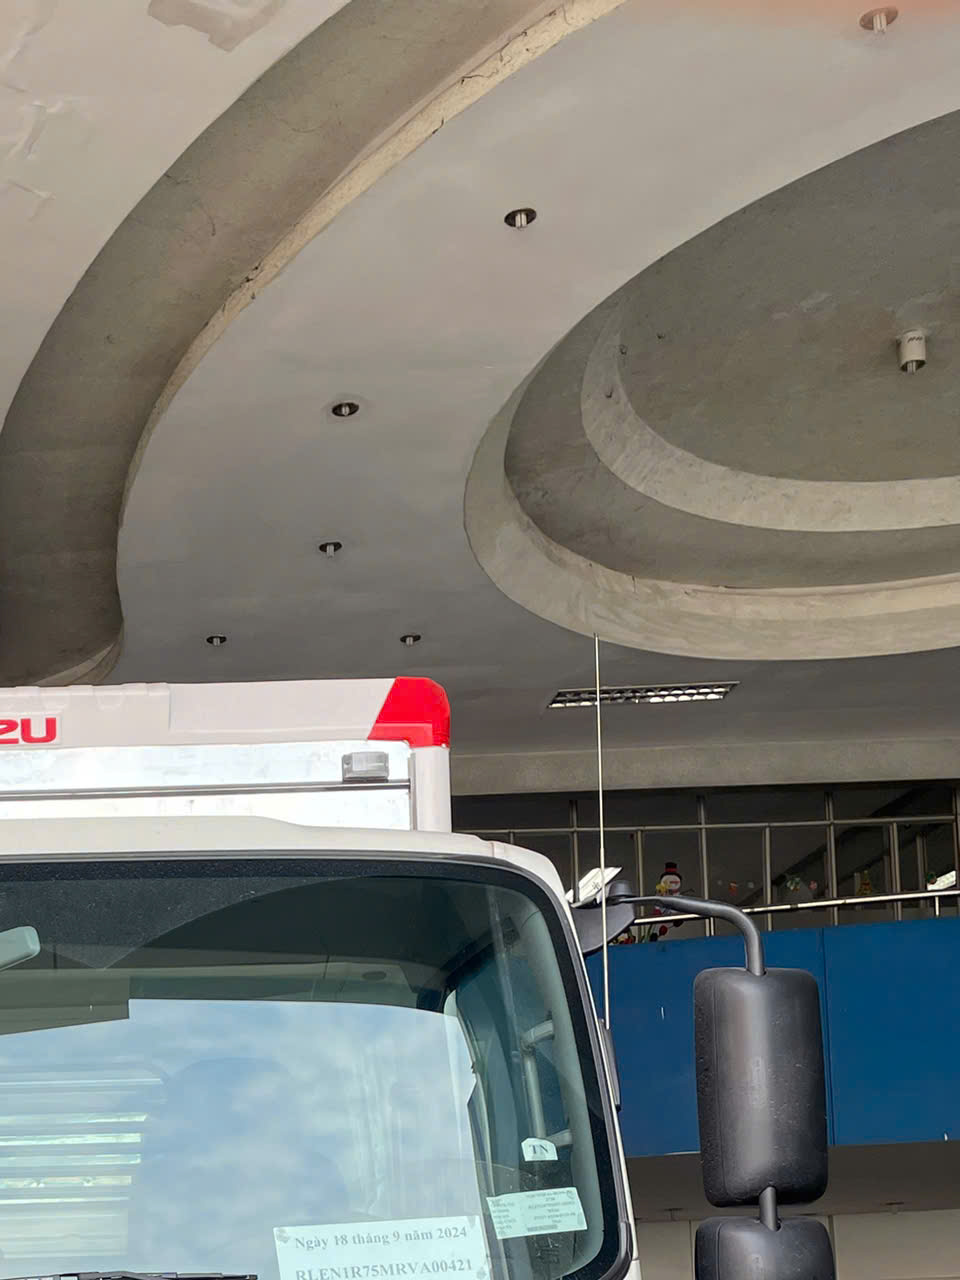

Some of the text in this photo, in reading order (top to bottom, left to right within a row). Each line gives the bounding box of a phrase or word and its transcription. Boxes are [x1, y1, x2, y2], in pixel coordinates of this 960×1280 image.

[295, 1226, 468, 1251] Ngày 18 tháng 9 năm 2024
